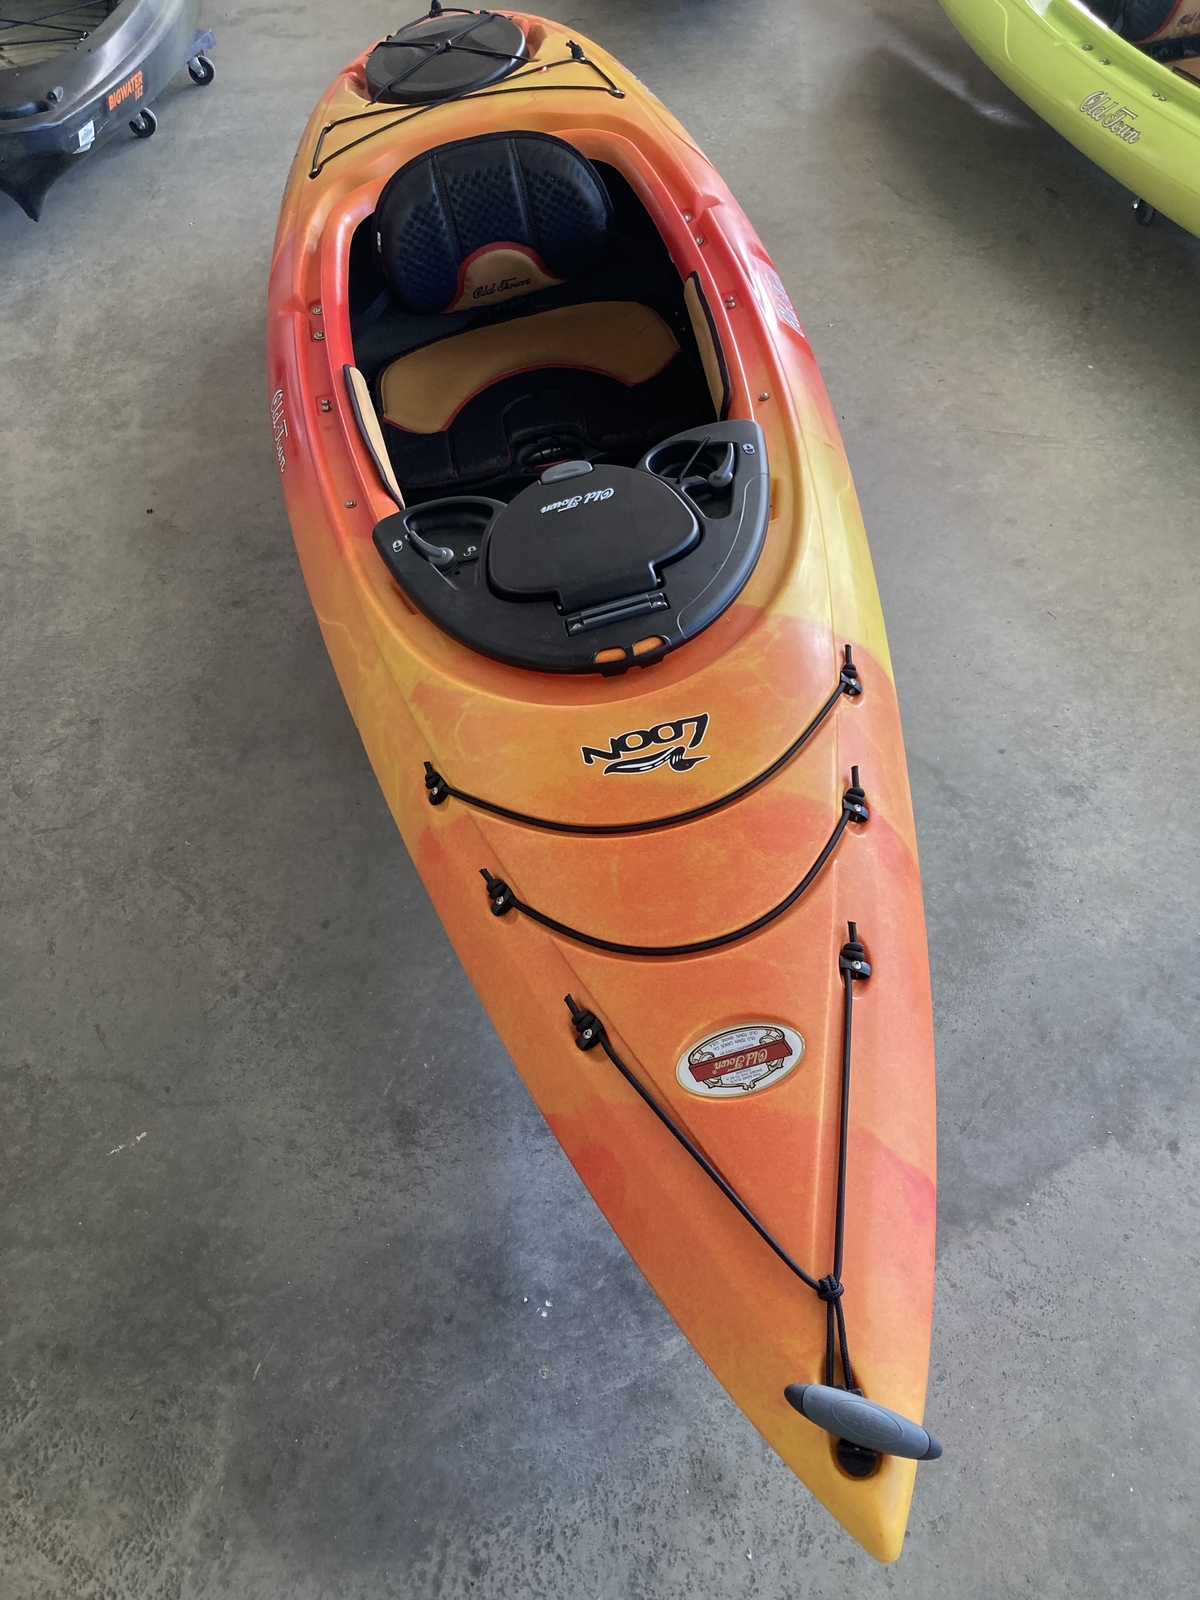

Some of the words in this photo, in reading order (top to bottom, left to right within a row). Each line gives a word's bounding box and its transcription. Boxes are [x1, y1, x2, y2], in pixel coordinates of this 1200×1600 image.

[108, 70, 143, 111] BIGWATER
[1079, 91, 1119, 121] Old
[1101, 106, 1141, 144] Town
[473, 283, 497, 299] Old
[497, 277, 532, 292] Town
[539, 495, 583, 514] Town
[583, 487, 615, 504] Old
[580, 711, 711, 766] LOON
[746, 1048, 768, 1066] Old
